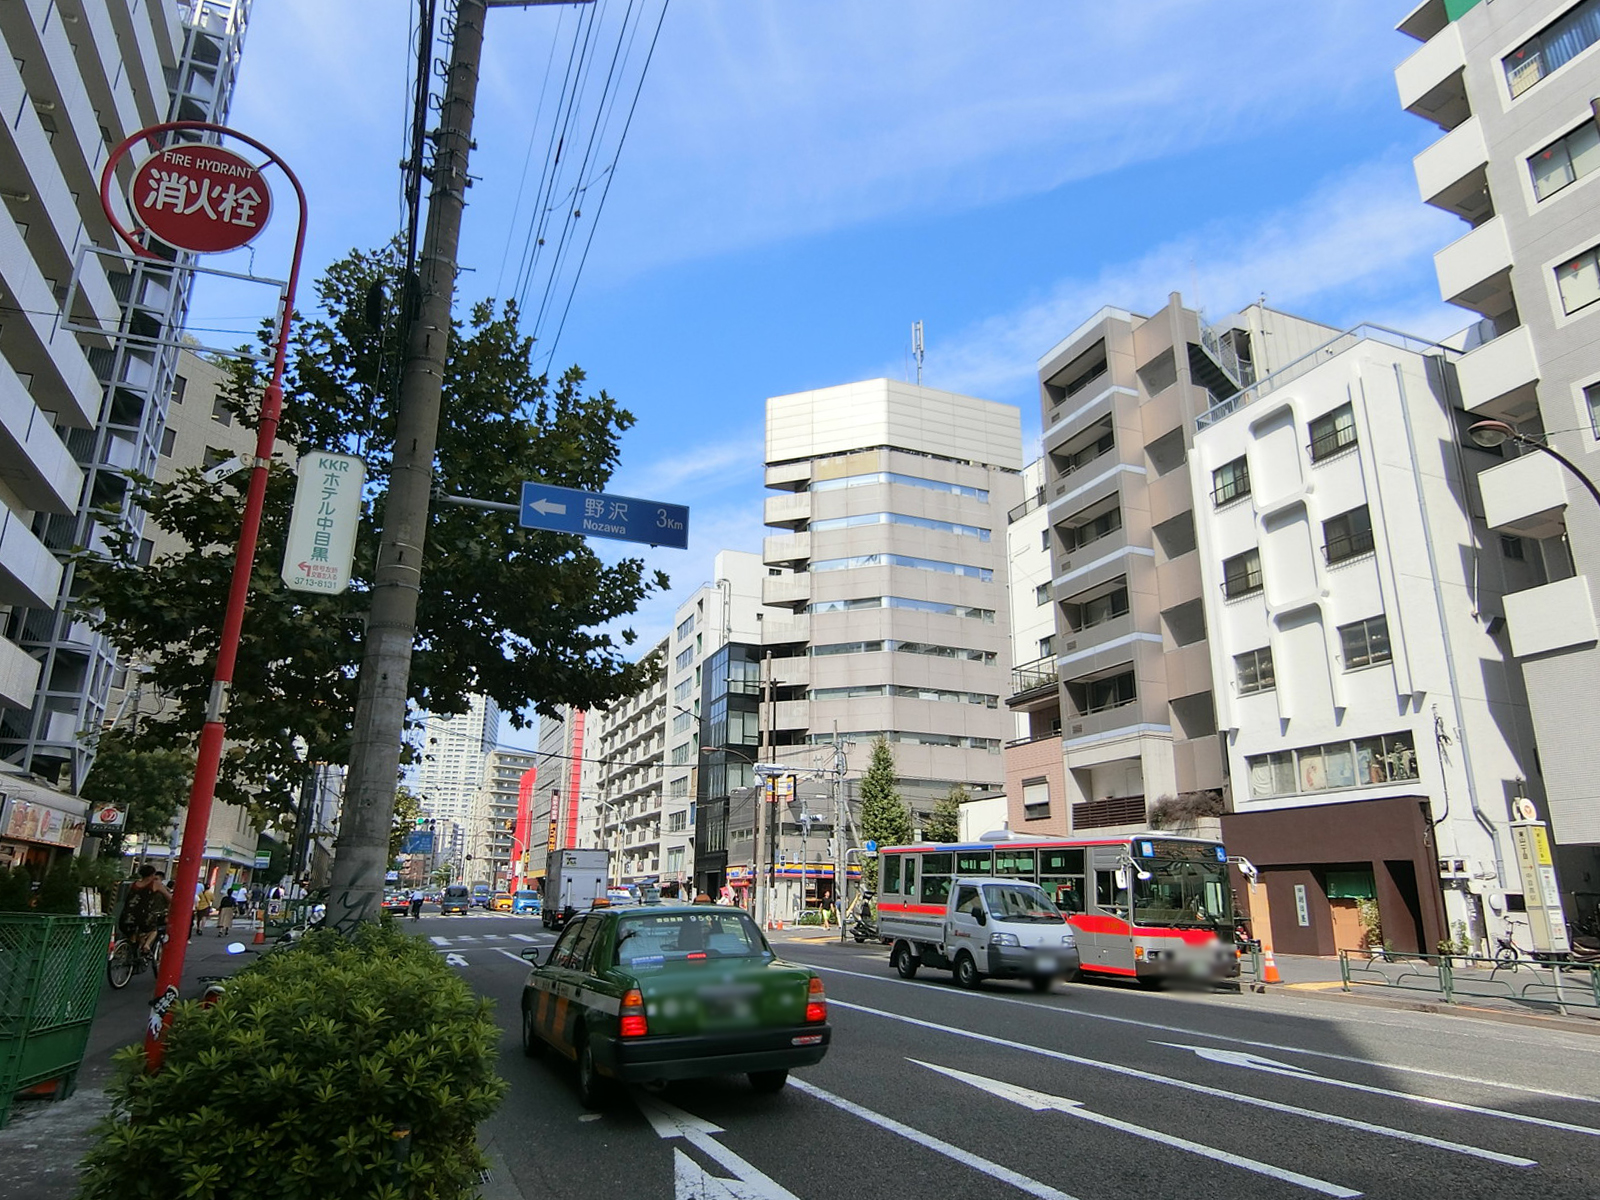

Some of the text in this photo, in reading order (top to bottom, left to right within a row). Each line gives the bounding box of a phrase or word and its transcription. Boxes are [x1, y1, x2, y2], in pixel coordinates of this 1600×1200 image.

[163, 152, 255, 179] FIRE HYDRANT
[143, 168, 262, 228] 消火栓
[318, 458, 350, 473] KKR
[310, 472, 341, 563] ホテル中目黒
[584, 497, 629, 522] 野沢
[656, 508, 683, 531] 3Km
[583, 518, 627, 535] Nozawa
